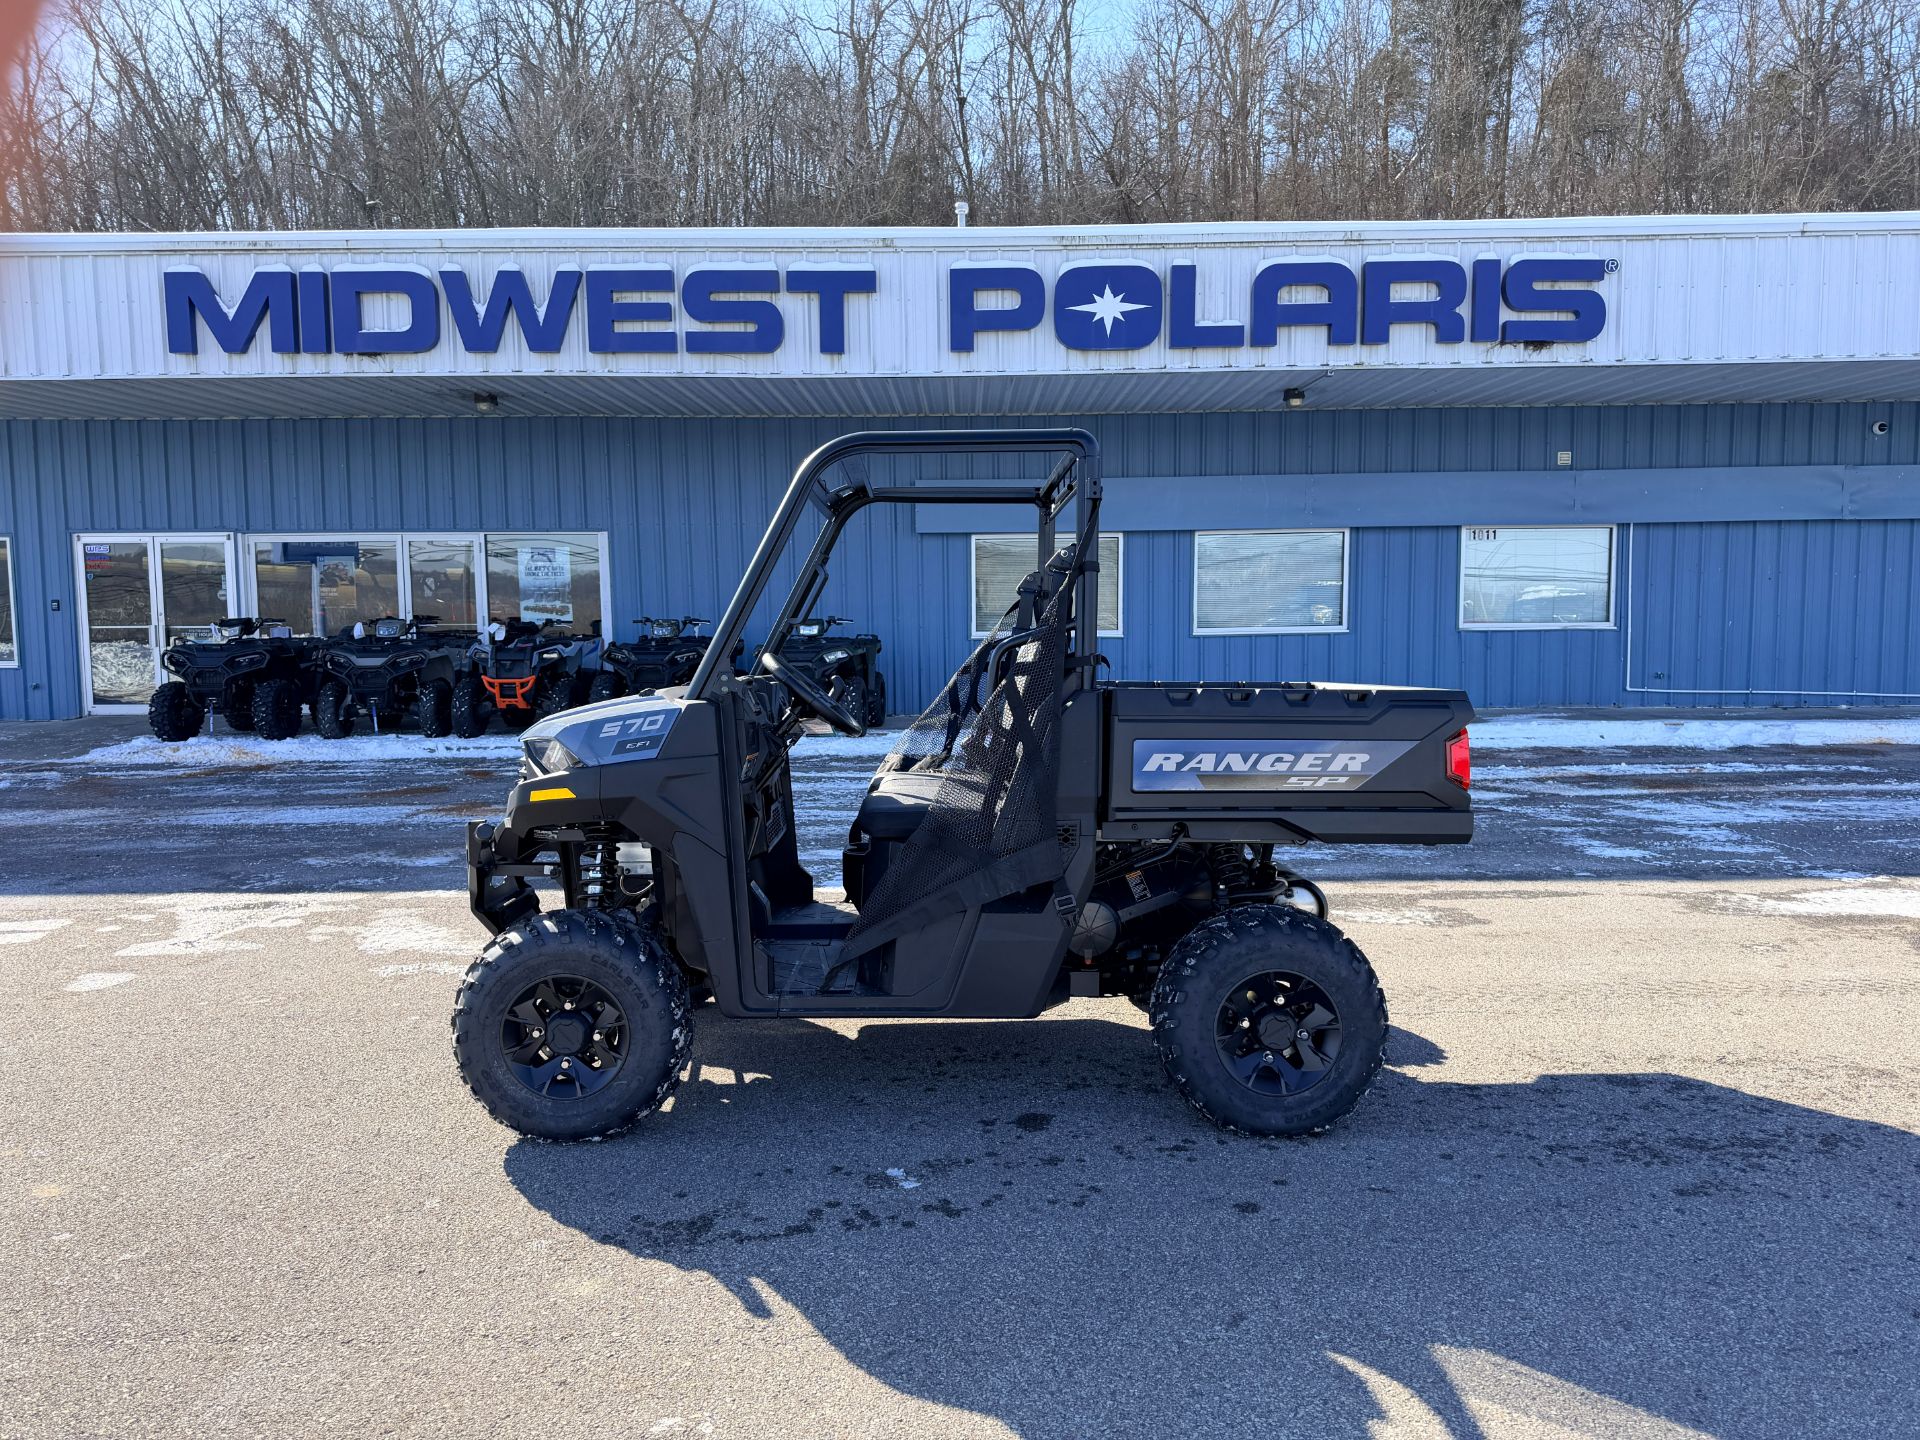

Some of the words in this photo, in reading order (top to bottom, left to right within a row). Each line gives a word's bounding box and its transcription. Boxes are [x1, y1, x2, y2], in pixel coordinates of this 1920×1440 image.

[163, 269, 878, 355] MIDWEST
[1472, 529, 1497, 541] 1011
[599, 715, 665, 738] 570
[626, 740, 650, 749] EFI
[1142, 753, 1371, 772] RANGER
[1283, 776, 1351, 788] SP
